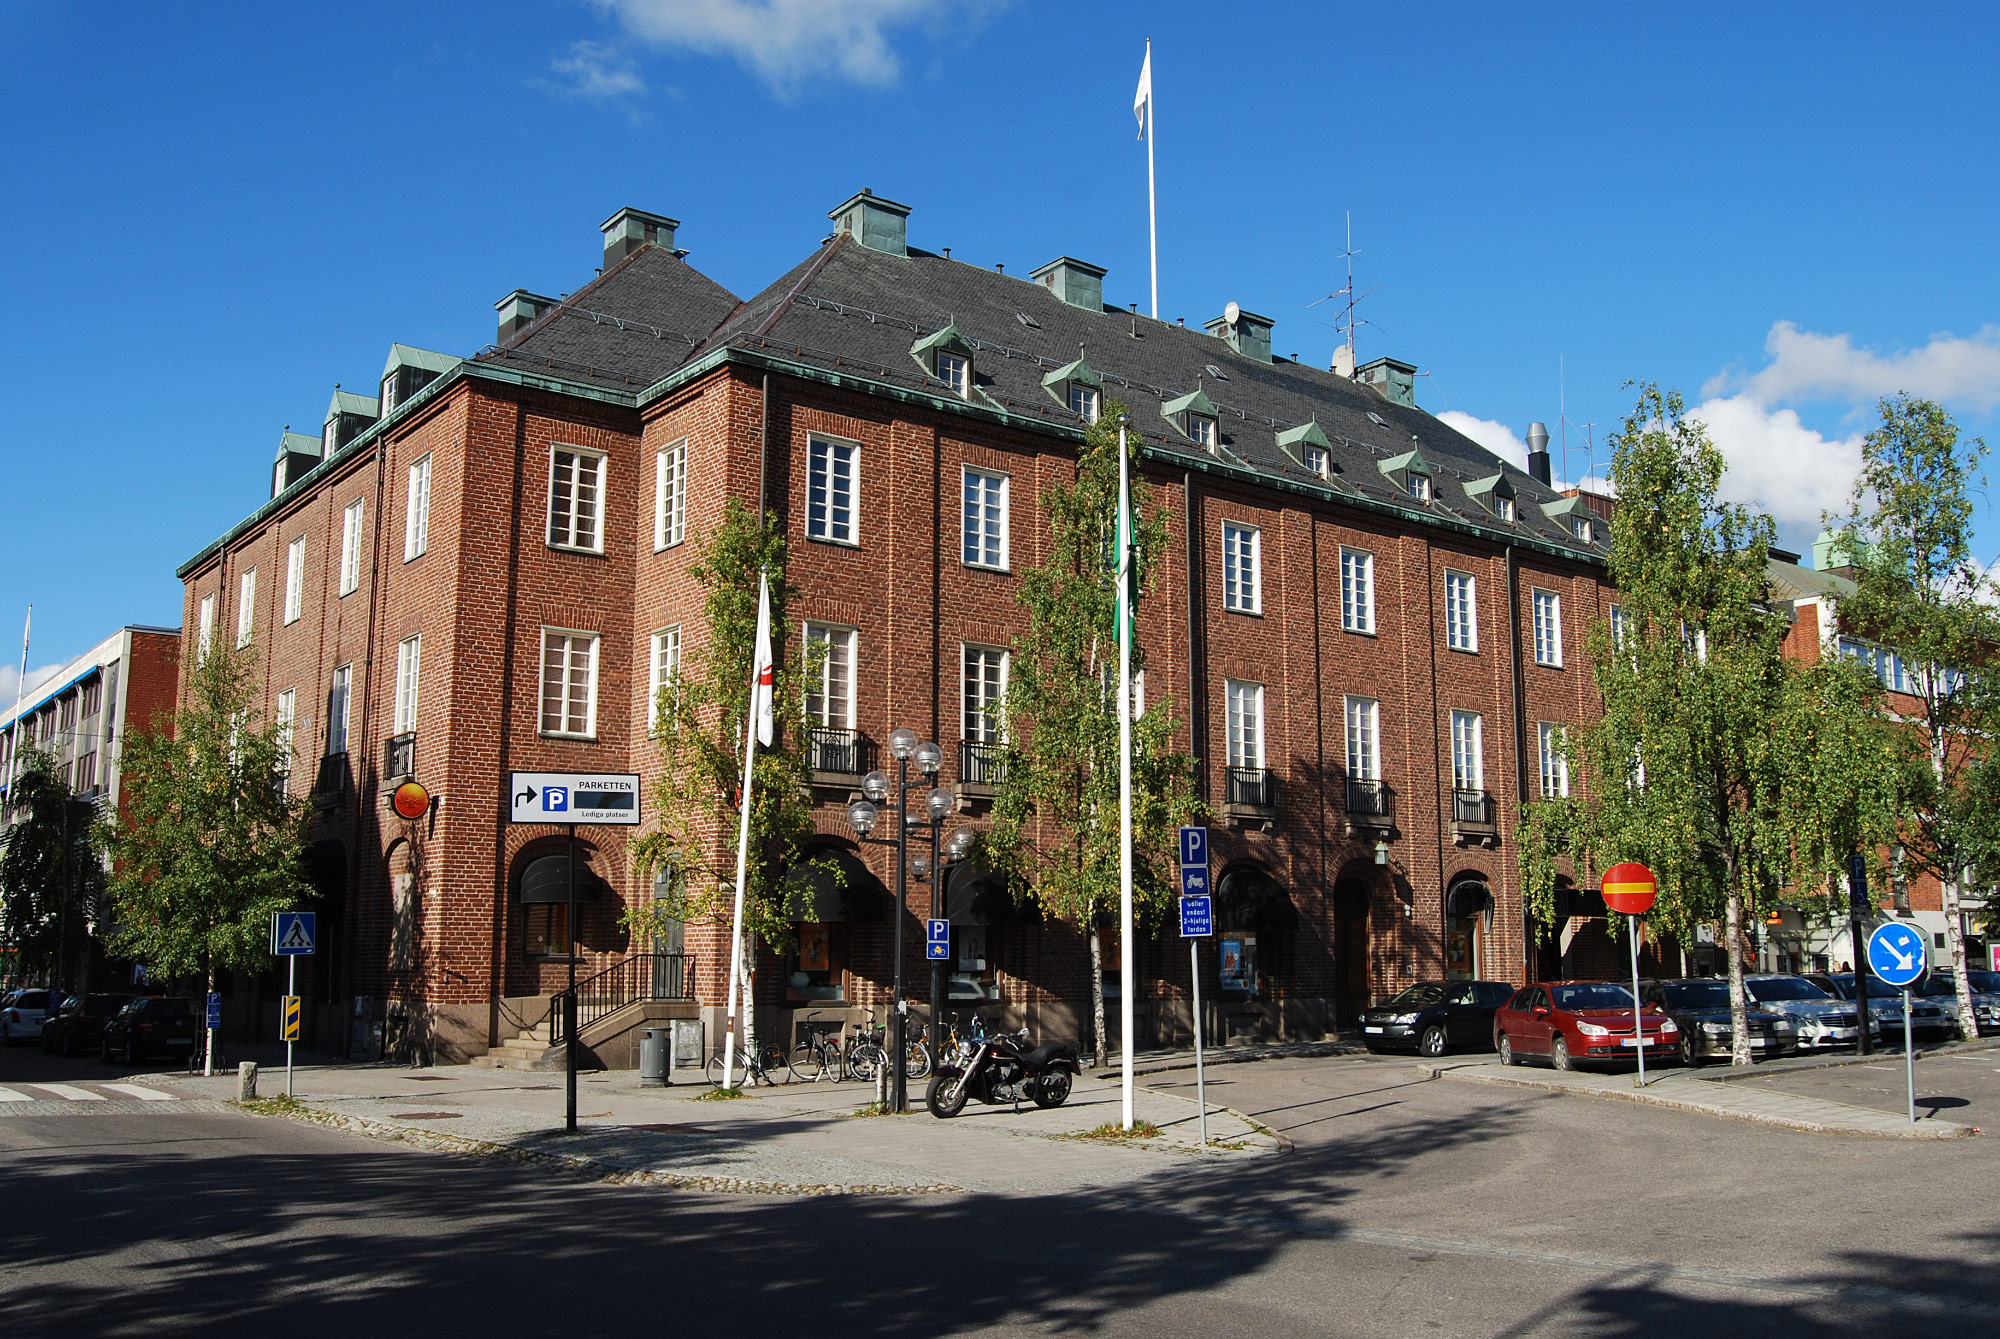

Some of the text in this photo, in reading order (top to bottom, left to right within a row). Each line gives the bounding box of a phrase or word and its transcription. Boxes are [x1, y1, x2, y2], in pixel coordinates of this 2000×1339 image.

[579, 781, 632, 790] PARKETTEN
[550, 792, 564, 810] P
[605, 811, 629, 819] platser
[1188, 832, 1200, 862] P
[934, 922, 944, 939] P
[212, 994, 218, 1002] P
